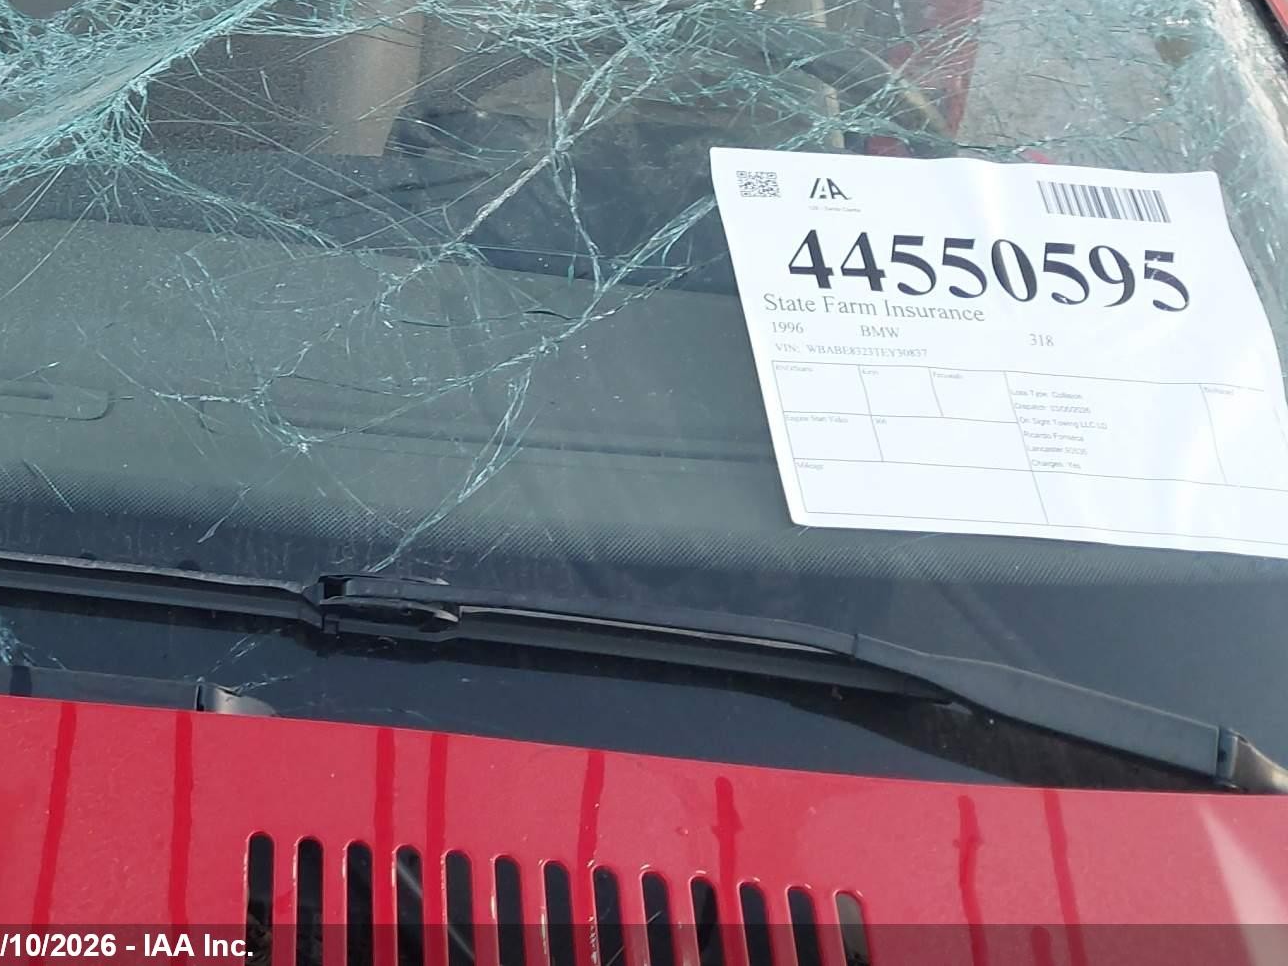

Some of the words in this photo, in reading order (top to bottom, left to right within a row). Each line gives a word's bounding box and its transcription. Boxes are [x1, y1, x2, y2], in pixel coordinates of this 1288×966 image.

[788, 229, 1190, 312] 44550595
[763, 292, 817, 313] State
[823, 295, 878, 317] Farm
[884, 299, 985, 322] Insurance
[772, 321, 805, 335] 1996
[860, 324, 901, 338] BMW
[1029, 333, 1055, 348] 318
